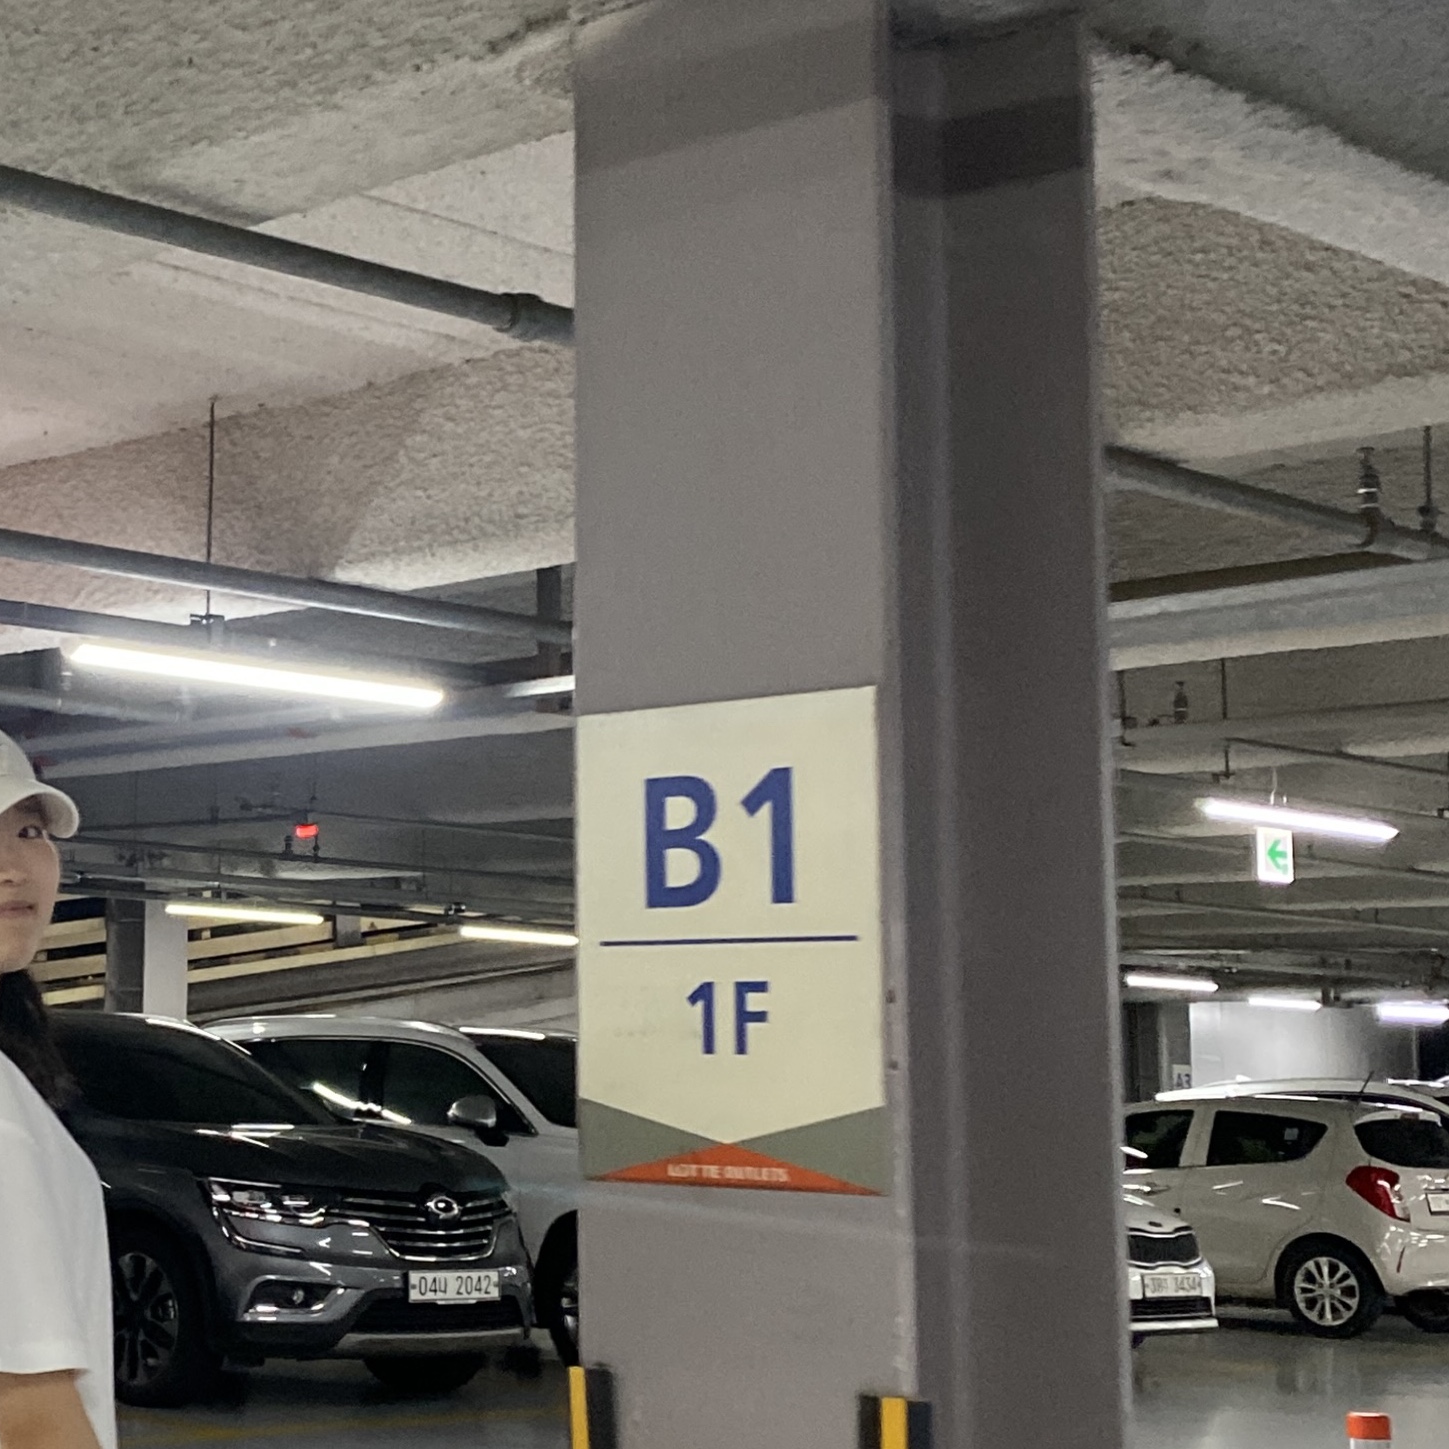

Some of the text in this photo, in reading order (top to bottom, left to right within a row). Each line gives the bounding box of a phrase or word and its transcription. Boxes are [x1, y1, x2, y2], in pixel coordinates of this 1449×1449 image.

[644, 766, 796, 909] B1
[686, 980, 770, 1055] 1F
[456, 1275, 492, 1296] 2042
